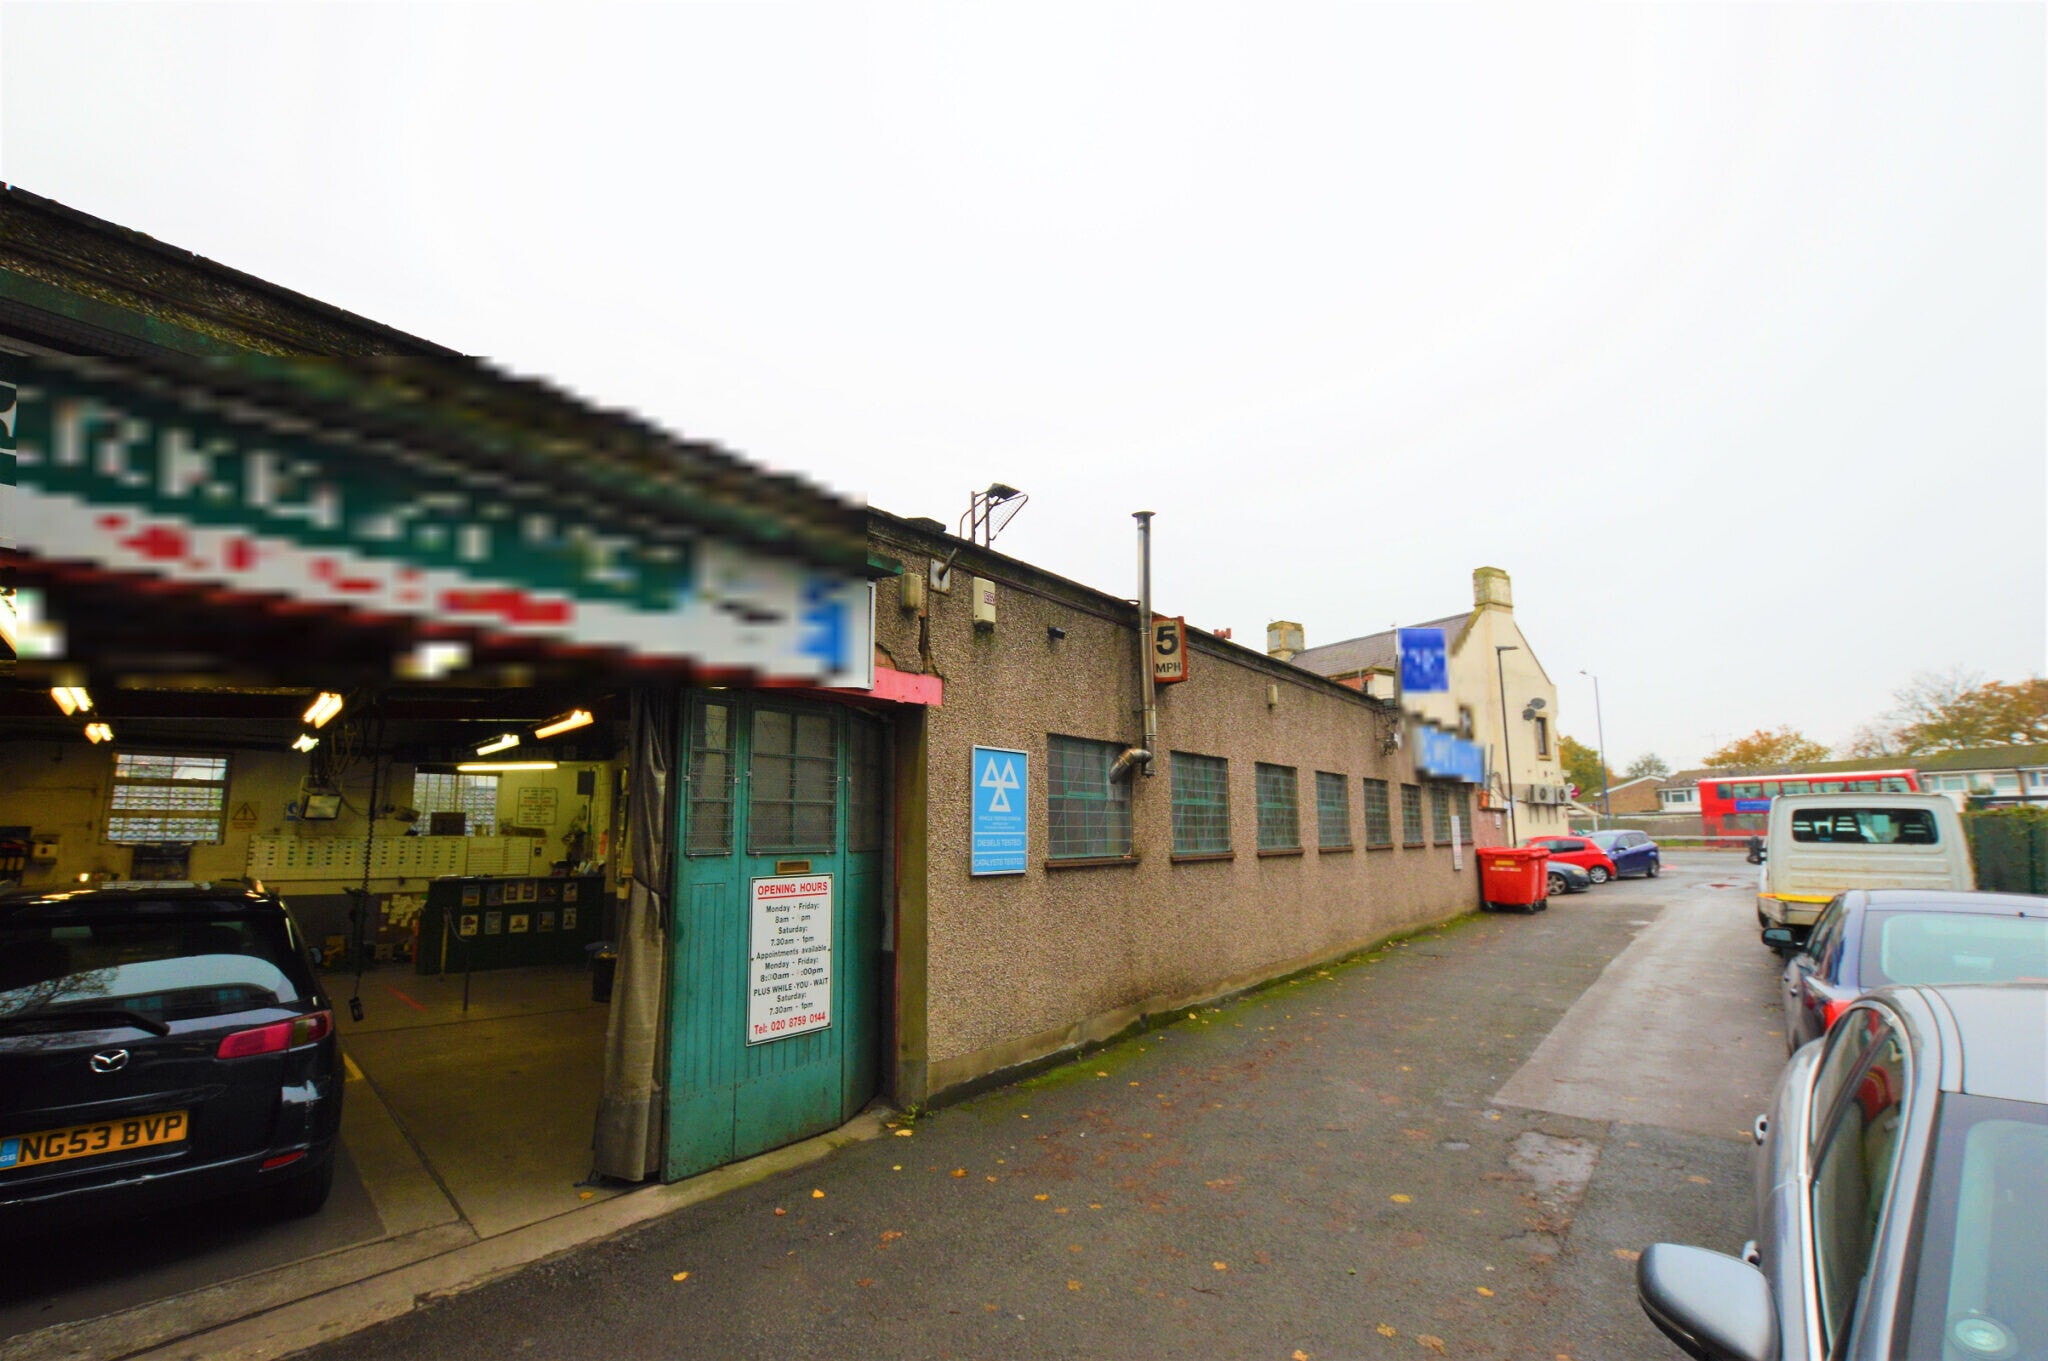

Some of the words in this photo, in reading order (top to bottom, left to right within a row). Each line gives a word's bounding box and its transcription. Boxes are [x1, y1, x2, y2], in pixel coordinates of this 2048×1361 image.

[1155, 625, 1179, 656] 5
[1155, 662, 1182, 673] MPH
[757, 883, 796, 896] OPENING
[800, 881, 828, 892] HOURS
[766, 905, 790, 913] Monday
[775, 916, 789, 924] 8am
[771, 938, 794, 946] 7.30am
[757, 948, 799, 960] Appointments
[802, 944, 827, 954] available
[765, 961, 790, 970] Monday
[754, 987, 771, 996] PLUS
[769, 1005, 793, 1015] 7.30am
[754, 1023, 768, 1035] Tel:
[770, 1019, 786, 1031] 020
[789, 1015, 807, 1028] 8759
[809, 1011, 826, 1023] 0144
[19, 1126, 112, 1163] NG53
[121, 1115, 183, 1146] BVP
